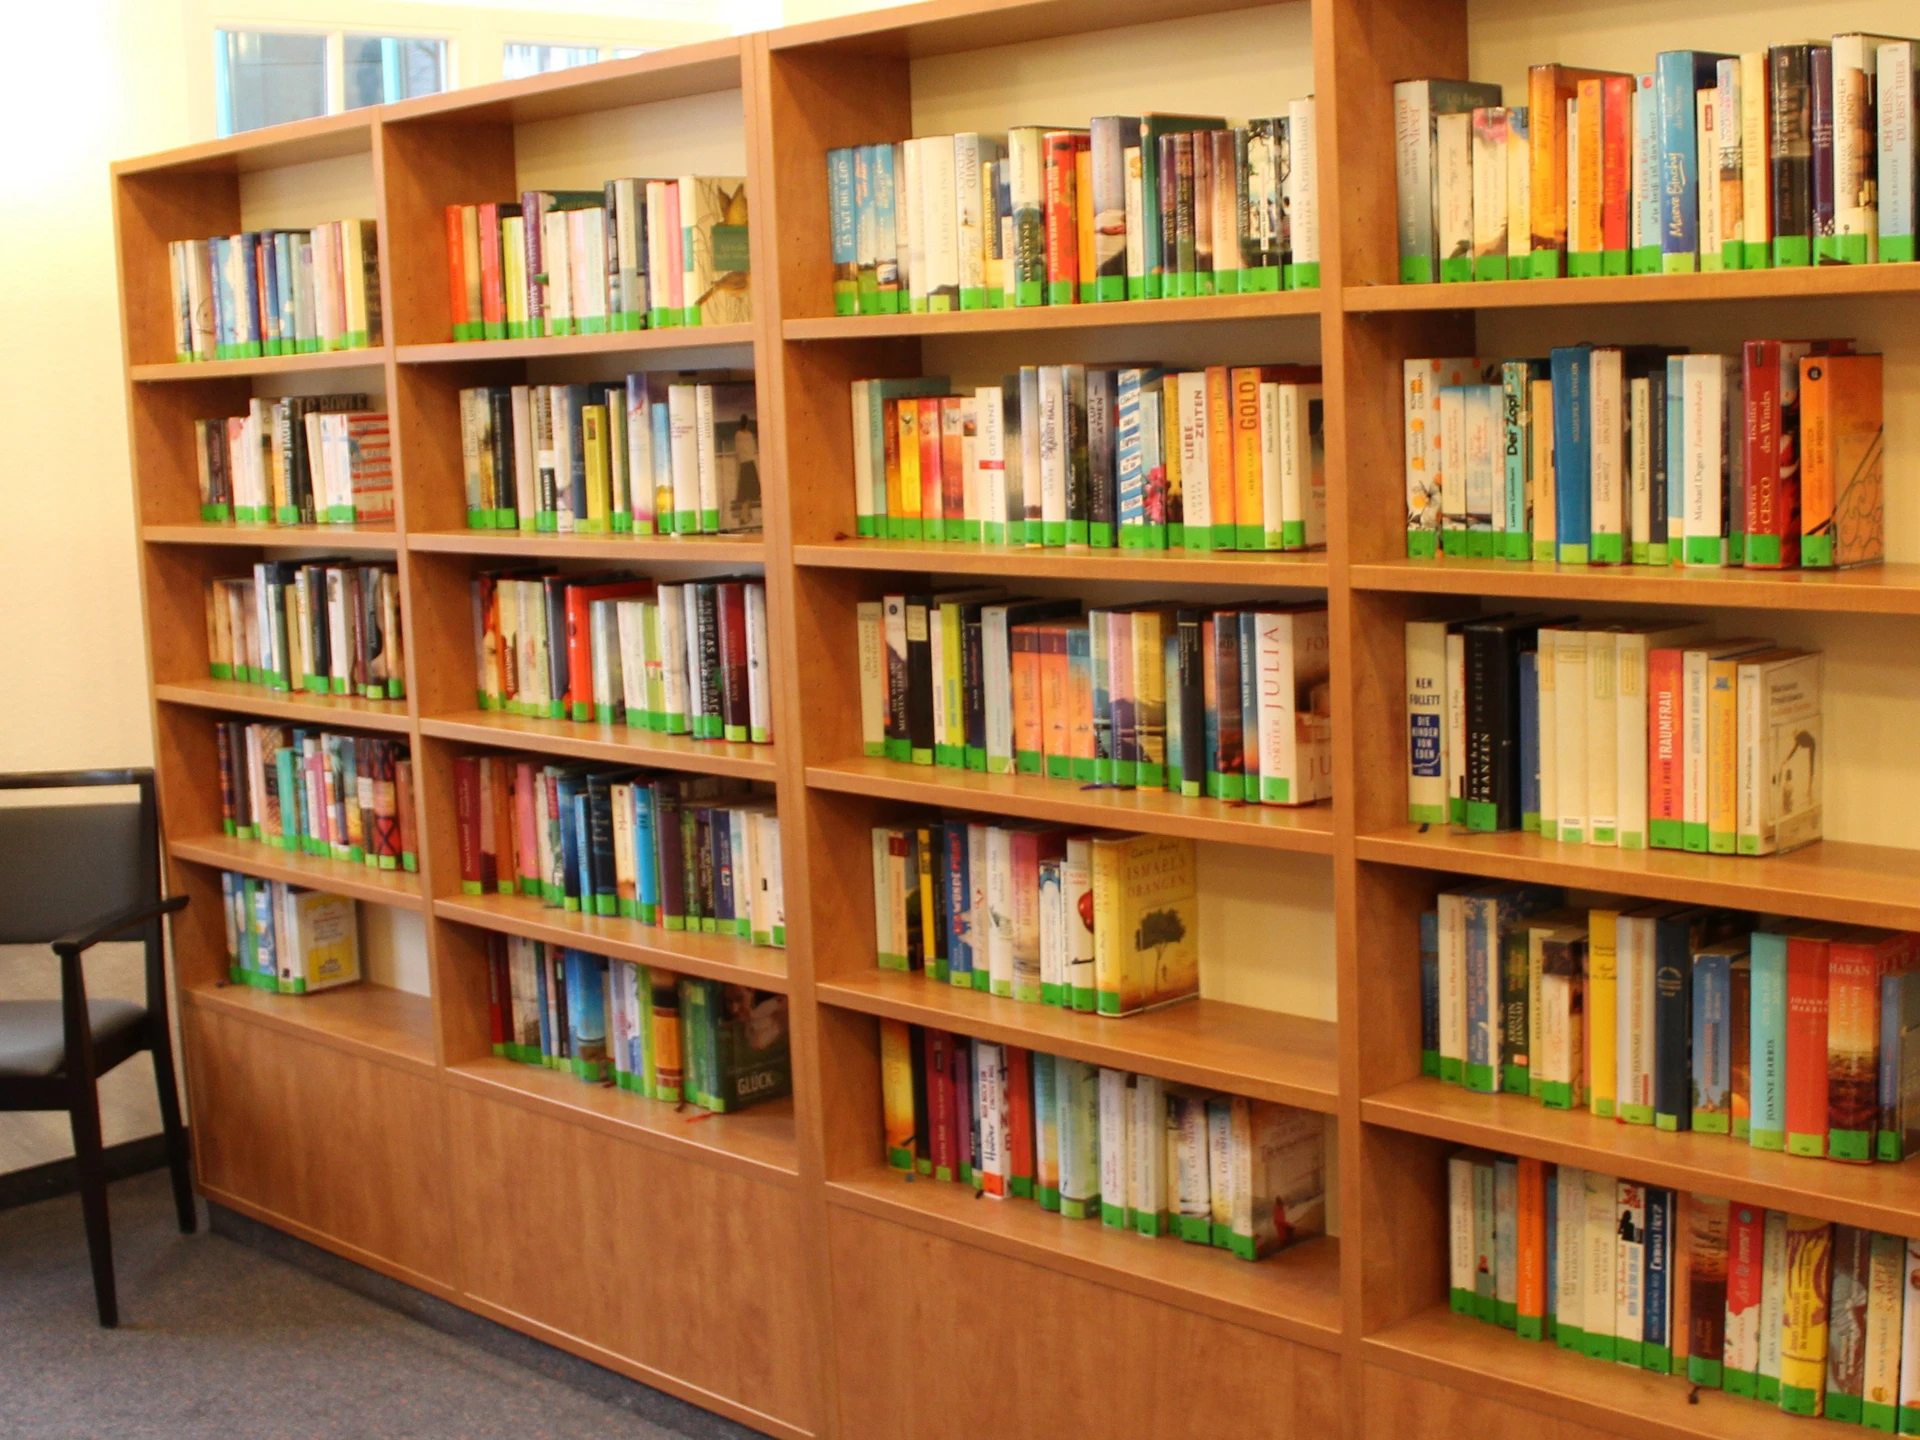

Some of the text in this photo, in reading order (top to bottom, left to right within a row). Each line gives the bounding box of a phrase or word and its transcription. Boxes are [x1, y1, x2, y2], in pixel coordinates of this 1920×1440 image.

[1398, 98, 1408, 140] Wind
[1410, 106, 1420, 145] Meer
[1838, 79, 1846, 141] TRÜMMER
[1847, 94, 1855, 124] KIND
[1895, 60, 1906, 141] DU BIST HIER
[1298, 116, 1310, 192] Kranichland
[1884, 130, 1893, 152] ICH
[965, 147, 976, 188] DAVID
[839, 161, 852, 246] ES TUT IHR LEID
[1667, 153, 1683, 236] Maeve Binchy
[988, 403, 996, 456] GESTIRNE
[1195, 390, 1204, 439] ZEITEN
[1213, 380, 1225, 434] Little Bee
[1239, 381, 1258, 430] GOLD
[1506, 394, 1518, 456] Der Zopf
[1748, 400, 1757, 441] Tochter
[1761, 391, 1770, 453] des Windes
[281, 420, 292, 458] BOYLE
[1184, 425, 1194, 460] LIEBE
[1694, 380, 1704, 520] Michael Degen Familienbande
[1761, 477, 1770, 524] CESCO
[704, 600, 715, 653] ANDREAS
[1263, 626, 1284, 711] JULIA
[1416, 678, 1433, 689] KEN
[1474, 641, 1483, 723] FREIHEIT
[1410, 694, 1441, 706] FOLLETT
[1417, 716, 1430, 726] DIE
[1659, 691, 1673, 759] TRAUMFRAU
[1272, 719, 1281, 771] FORTIER
[1412, 726, 1439, 737] KINDER
[1415, 749, 1435, 759] EDEN
[1470, 732, 1478, 802] Jonathan
[1480, 733, 1490, 803] FRANZEN
[949, 832, 963, 934] DER WUNDE PUNKT
[1829, 963, 1870, 975] HARAN
[1516, 1001, 1524, 1045] HANNAH
[738, 1071, 773, 1095] GLÜCK
[1766, 1039, 1775, 1121] JOANNE HARRIS
